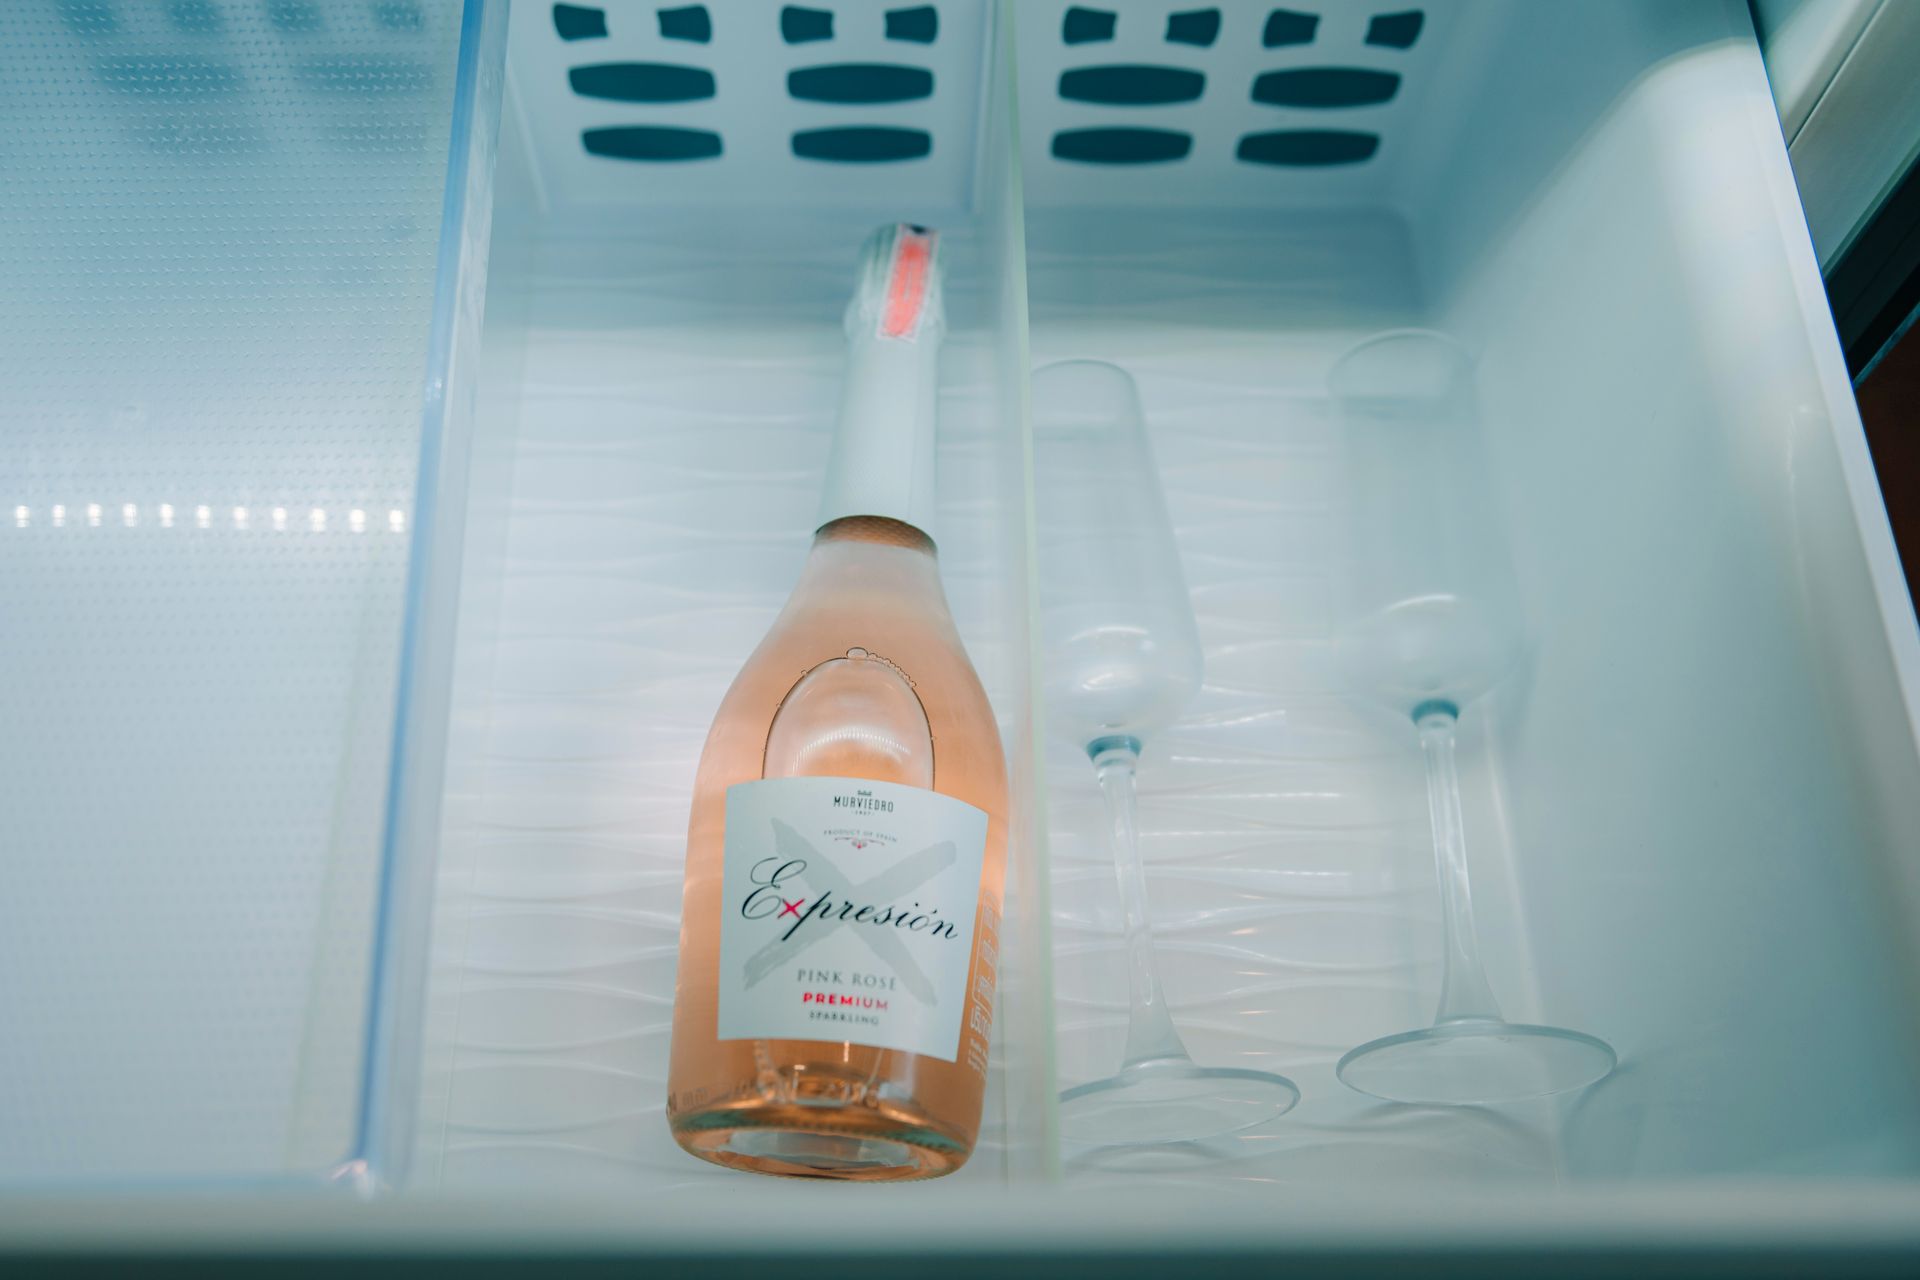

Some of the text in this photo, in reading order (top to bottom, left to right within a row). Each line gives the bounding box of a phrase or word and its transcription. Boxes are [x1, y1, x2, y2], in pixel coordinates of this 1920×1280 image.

[834, 796, 894, 813] MURVIEDRO
[742, 857, 958, 941] Expresión
[798, 969, 842, 983] PINK
[803, 992, 888, 1010] PREMIUM
[809, 1010, 879, 1025] SPARKLING
